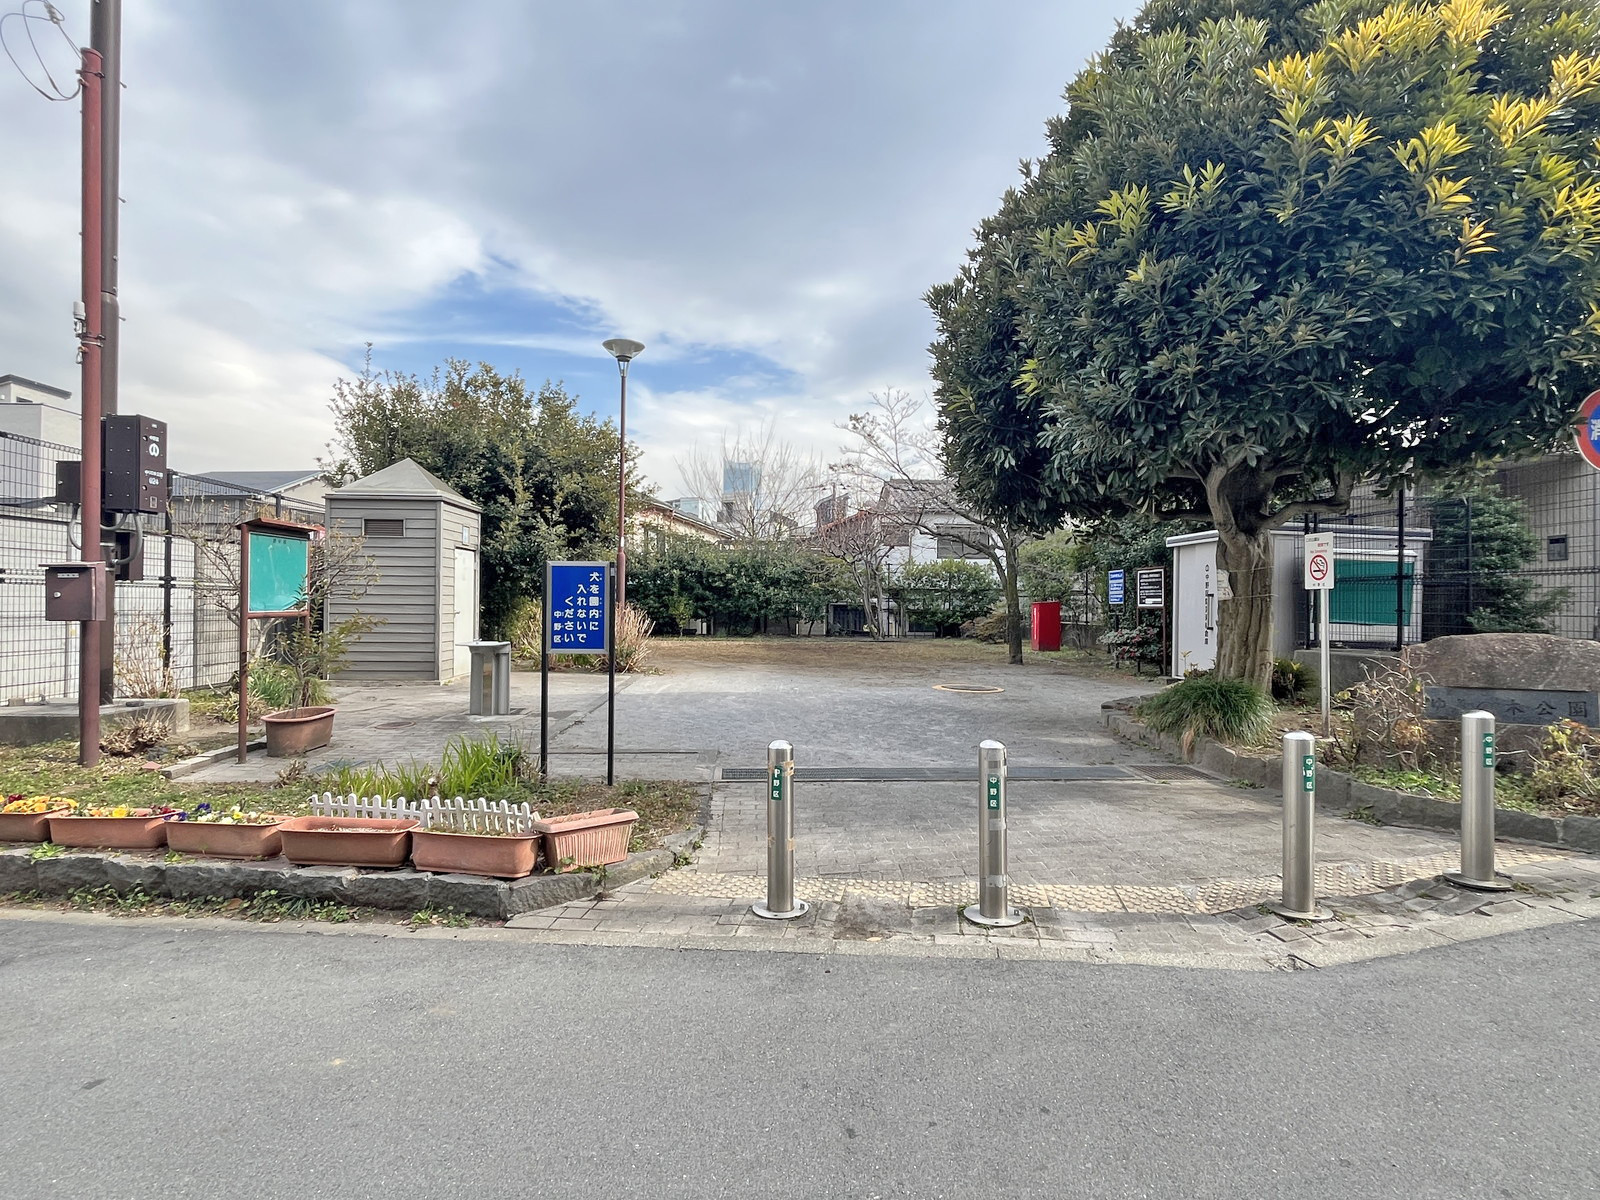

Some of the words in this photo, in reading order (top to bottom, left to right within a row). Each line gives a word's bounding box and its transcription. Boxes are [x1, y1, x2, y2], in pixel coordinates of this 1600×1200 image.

[564, 596, 574, 642] ください
[576, 584, 587, 643] 入れないで
[589, 571, 600, 631] 犬を園内に
[553, 610, 562, 643] 中野区
[1430, 697, 1588, 718] ゆ木公園
